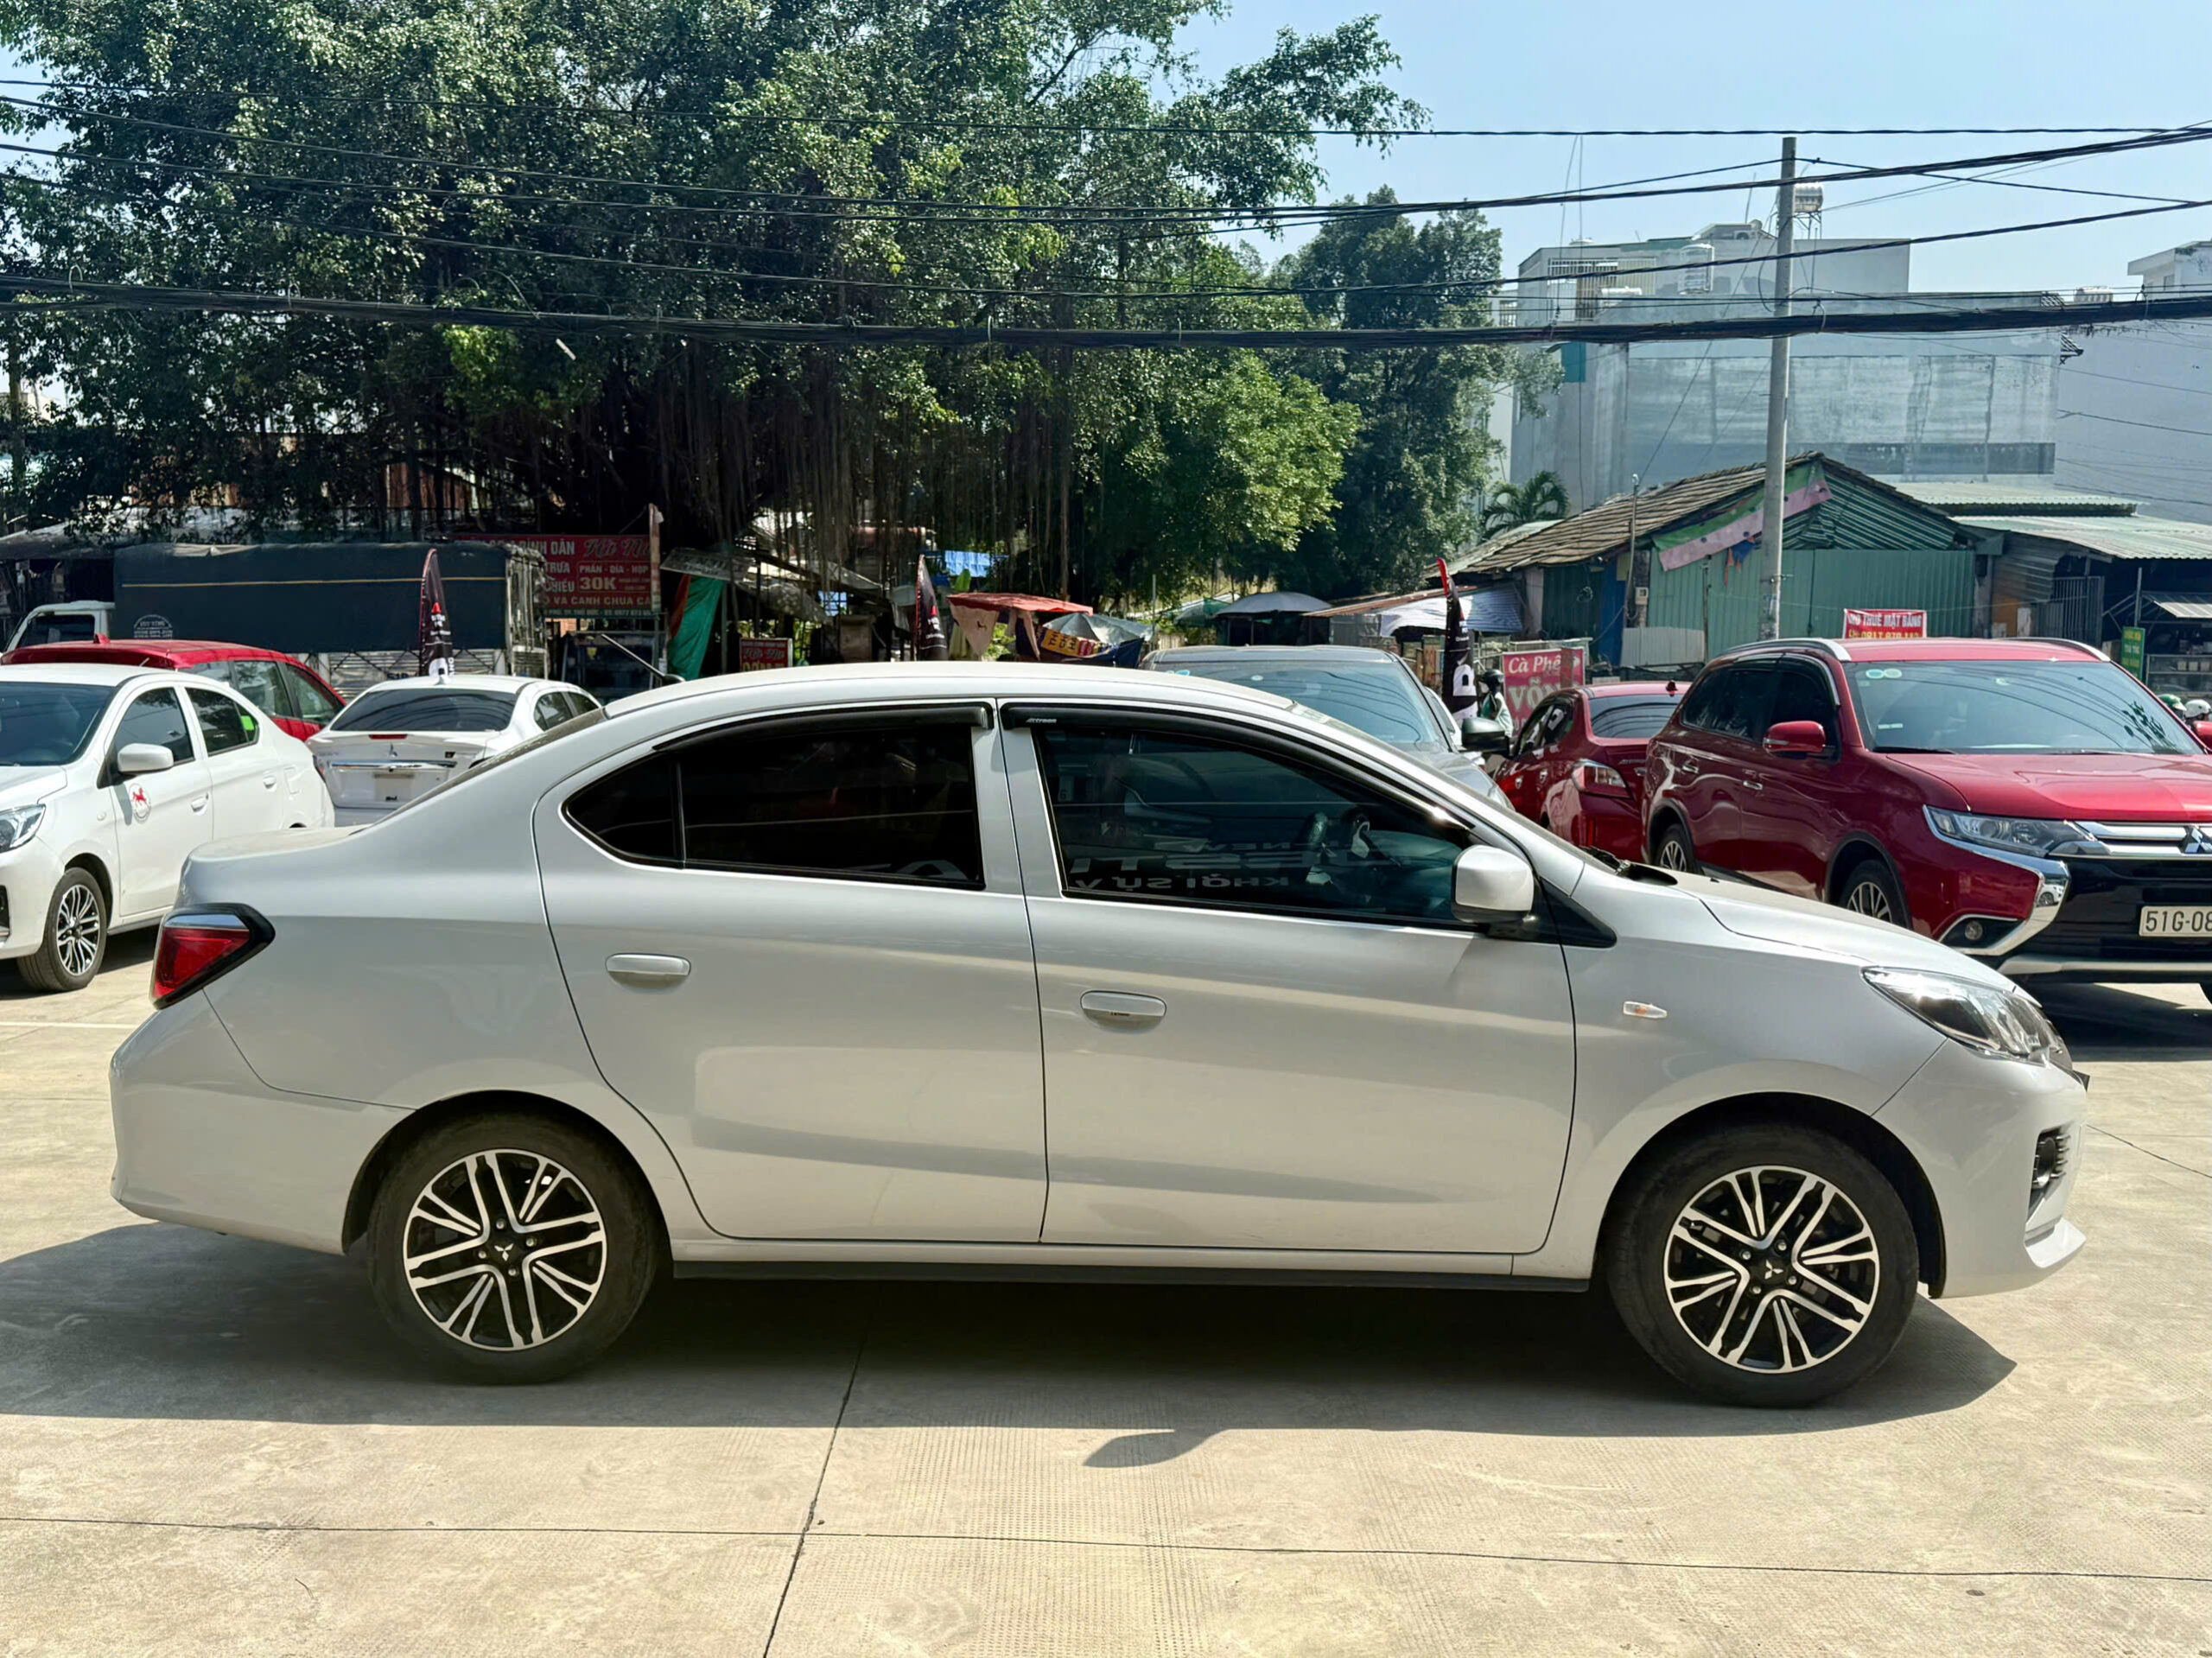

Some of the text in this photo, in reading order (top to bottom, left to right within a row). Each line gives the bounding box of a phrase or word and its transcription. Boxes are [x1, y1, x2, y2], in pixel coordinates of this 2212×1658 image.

[580, 576, 616, 590] 30K
[1508, 654, 1561, 674] Cà Phê
[2145, 910, 2212, 932] 51G-08
